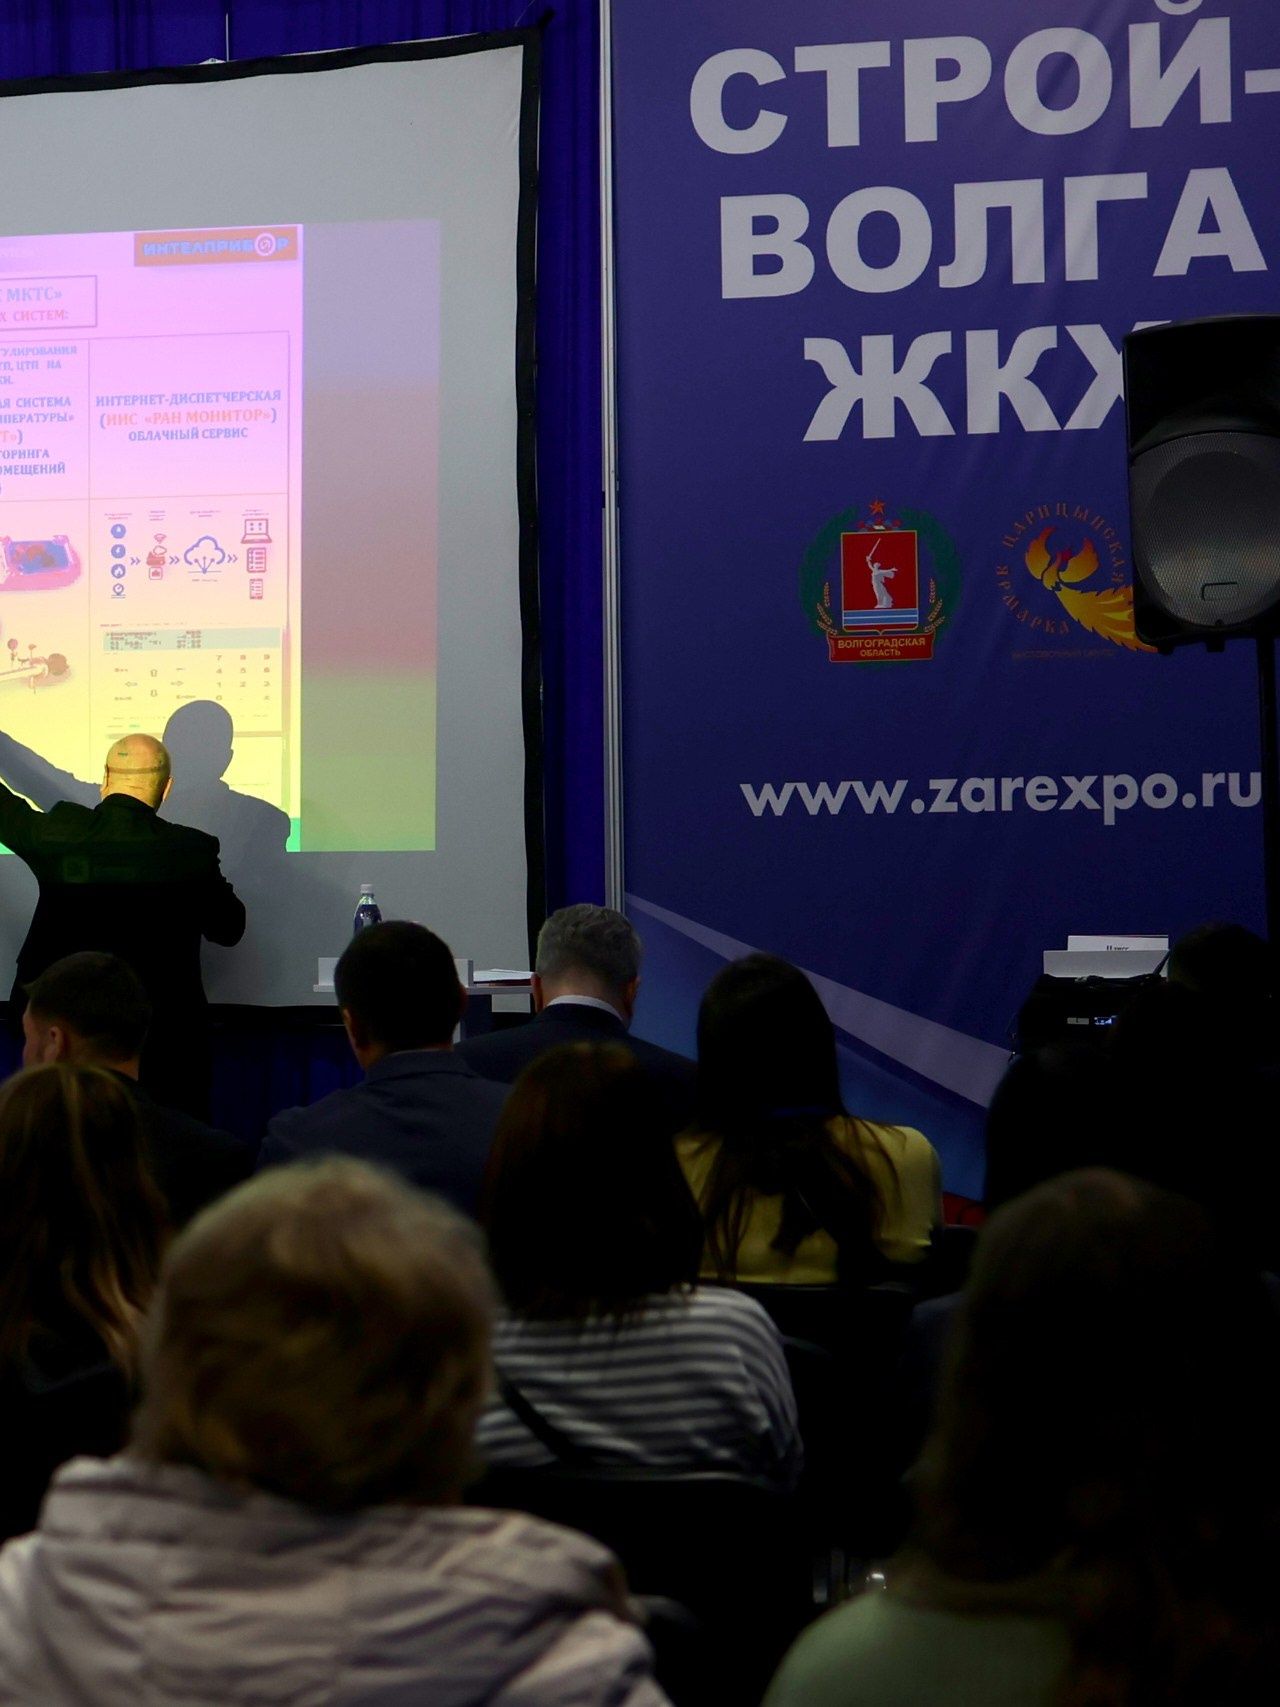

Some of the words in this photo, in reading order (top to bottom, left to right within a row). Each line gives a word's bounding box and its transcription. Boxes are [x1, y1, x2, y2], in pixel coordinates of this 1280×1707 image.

[690, 0, 1280, 154] СТРОЙ-
[721, 167, 1268, 299] ВОЛГА
[6, 286, 63, 302] МКТС»
[13, 309, 69, 322] СИСТЕМ:
[47, 359, 62, 370] НА
[15, 396, 72, 409] СИСТЕМА
[95, 389, 282, 407] ИНТЕРНЕТ-ДИСПЕТЧЕРСКАЯ
[128, 427, 199, 442] ОБЛАЧНЫЙ
[201, 427, 249, 439] СЕРВИС
[837, 637, 926, 649] ВОЛГОГРАДСКАЯ
[859, 648, 901, 657] ОБЛАСТЬ
[739, 770, 1263, 826] www.zarexpo.ru
